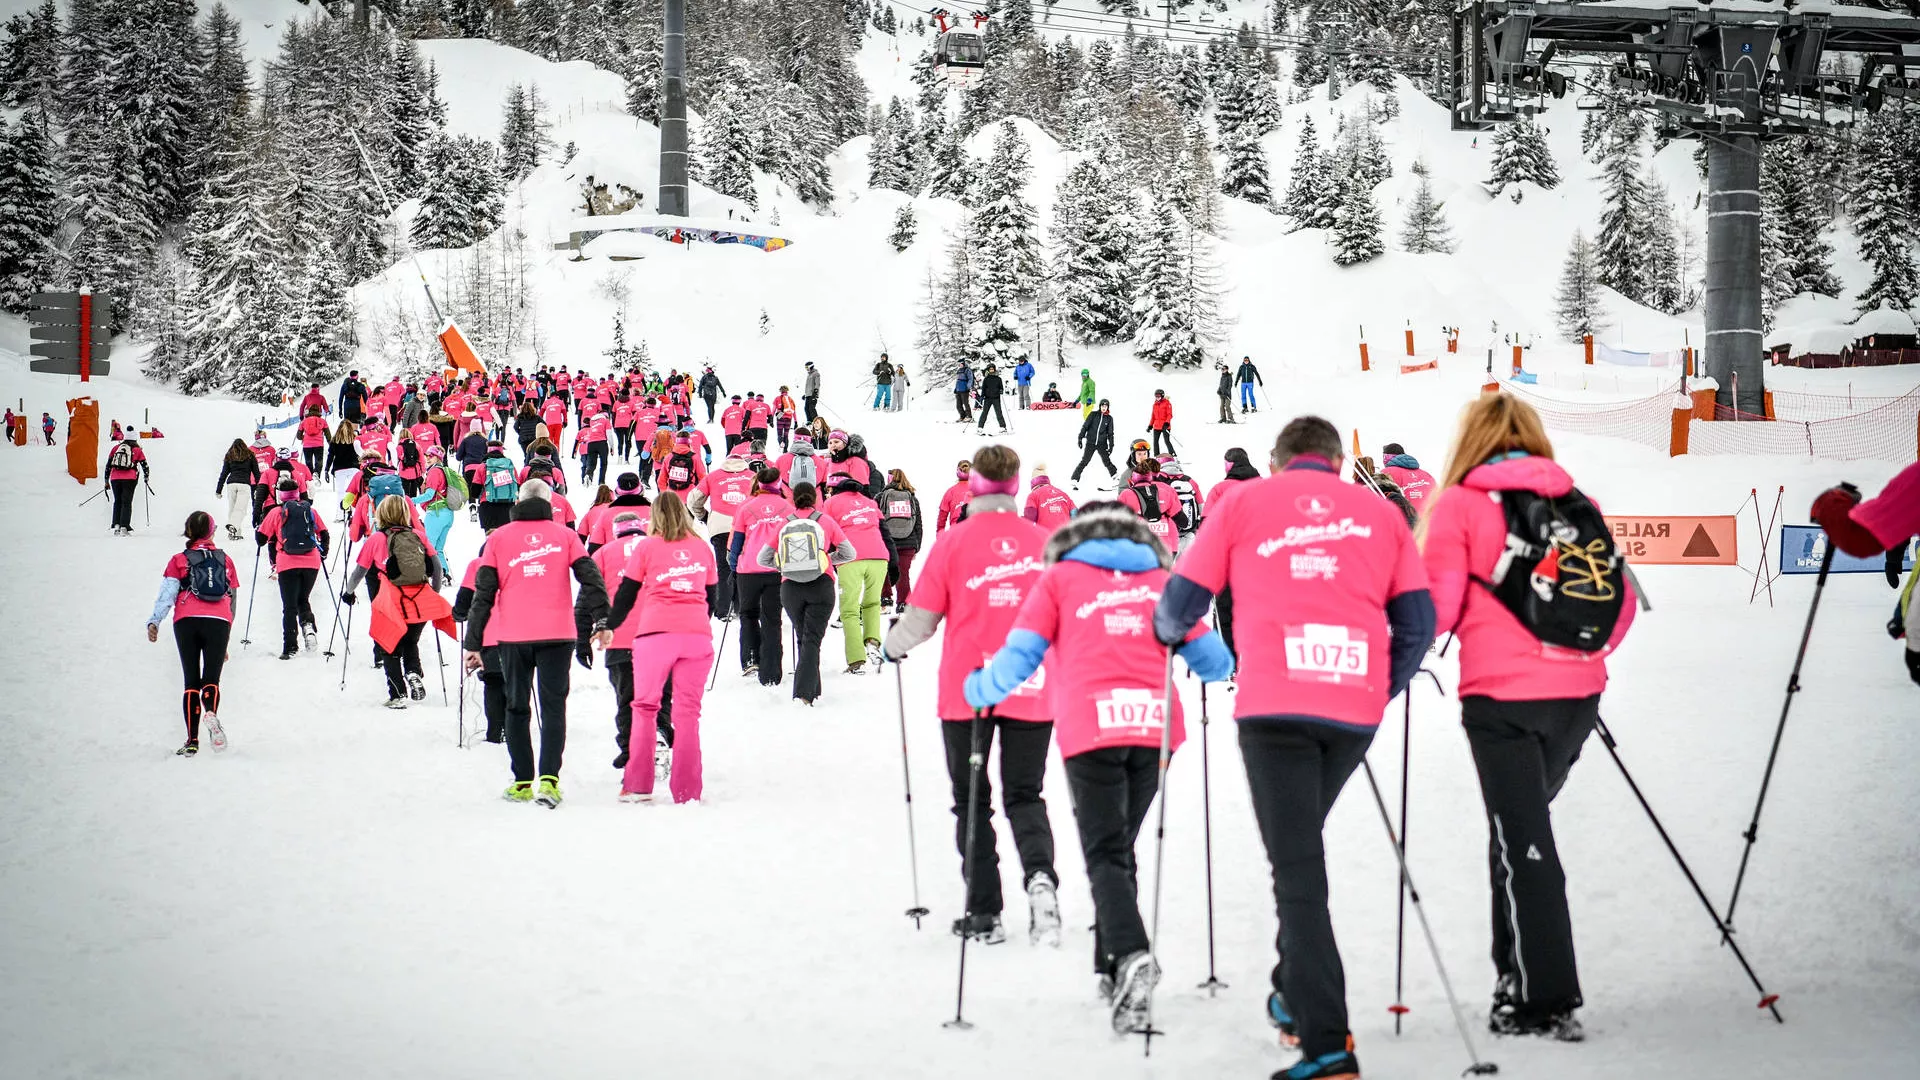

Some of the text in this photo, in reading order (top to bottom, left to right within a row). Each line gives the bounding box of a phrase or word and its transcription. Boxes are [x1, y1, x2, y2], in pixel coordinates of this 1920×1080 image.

[1150, 523, 1167, 532] 027
[1296, 643, 1360, 670] 1075
[1107, 703, 1164, 723] 1074
